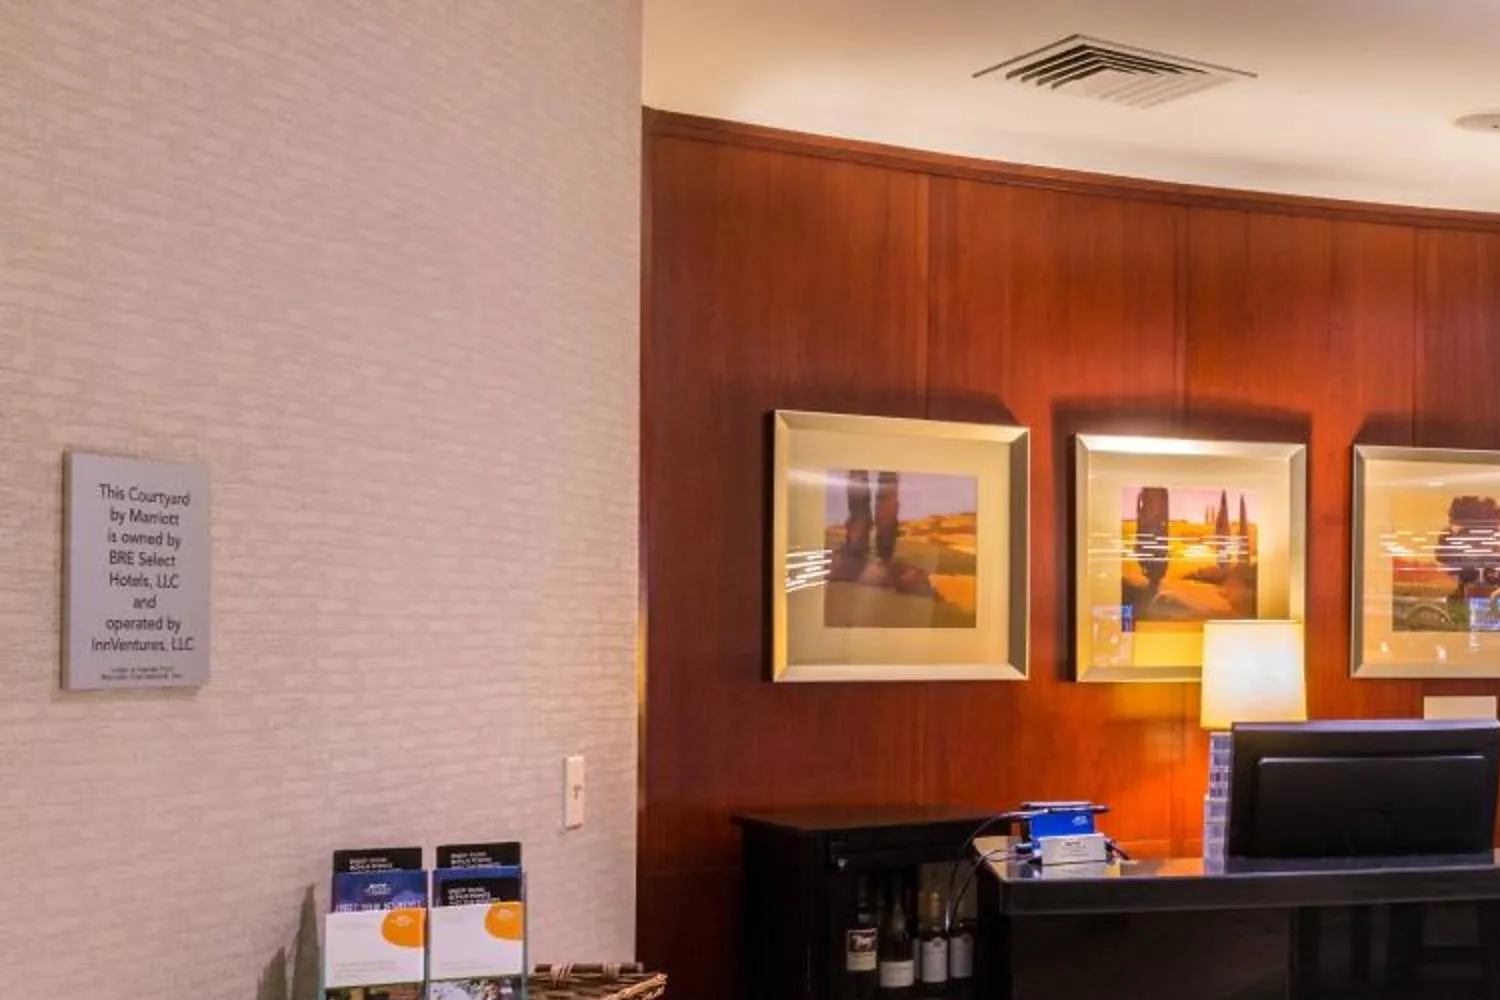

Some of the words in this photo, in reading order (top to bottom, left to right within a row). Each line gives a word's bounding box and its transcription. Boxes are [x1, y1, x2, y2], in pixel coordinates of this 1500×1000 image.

[99, 483, 125, 500] This
[128, 486, 190, 508] Courtyard
[110, 505, 125, 526] by
[129, 507, 179, 526] Marriott
[107, 529, 117, 543] is
[121, 532, 163, 545] owned
[167, 532, 181, 551] by
[109, 549, 135, 566] BRE
[139, 551, 175, 567] Select
[157, 573, 179, 589] LLC
[133, 594, 157, 609] and
[105, 616, 163, 634] operated
[167, 616, 181, 635] by
[171, 636, 194, 651] LLC
